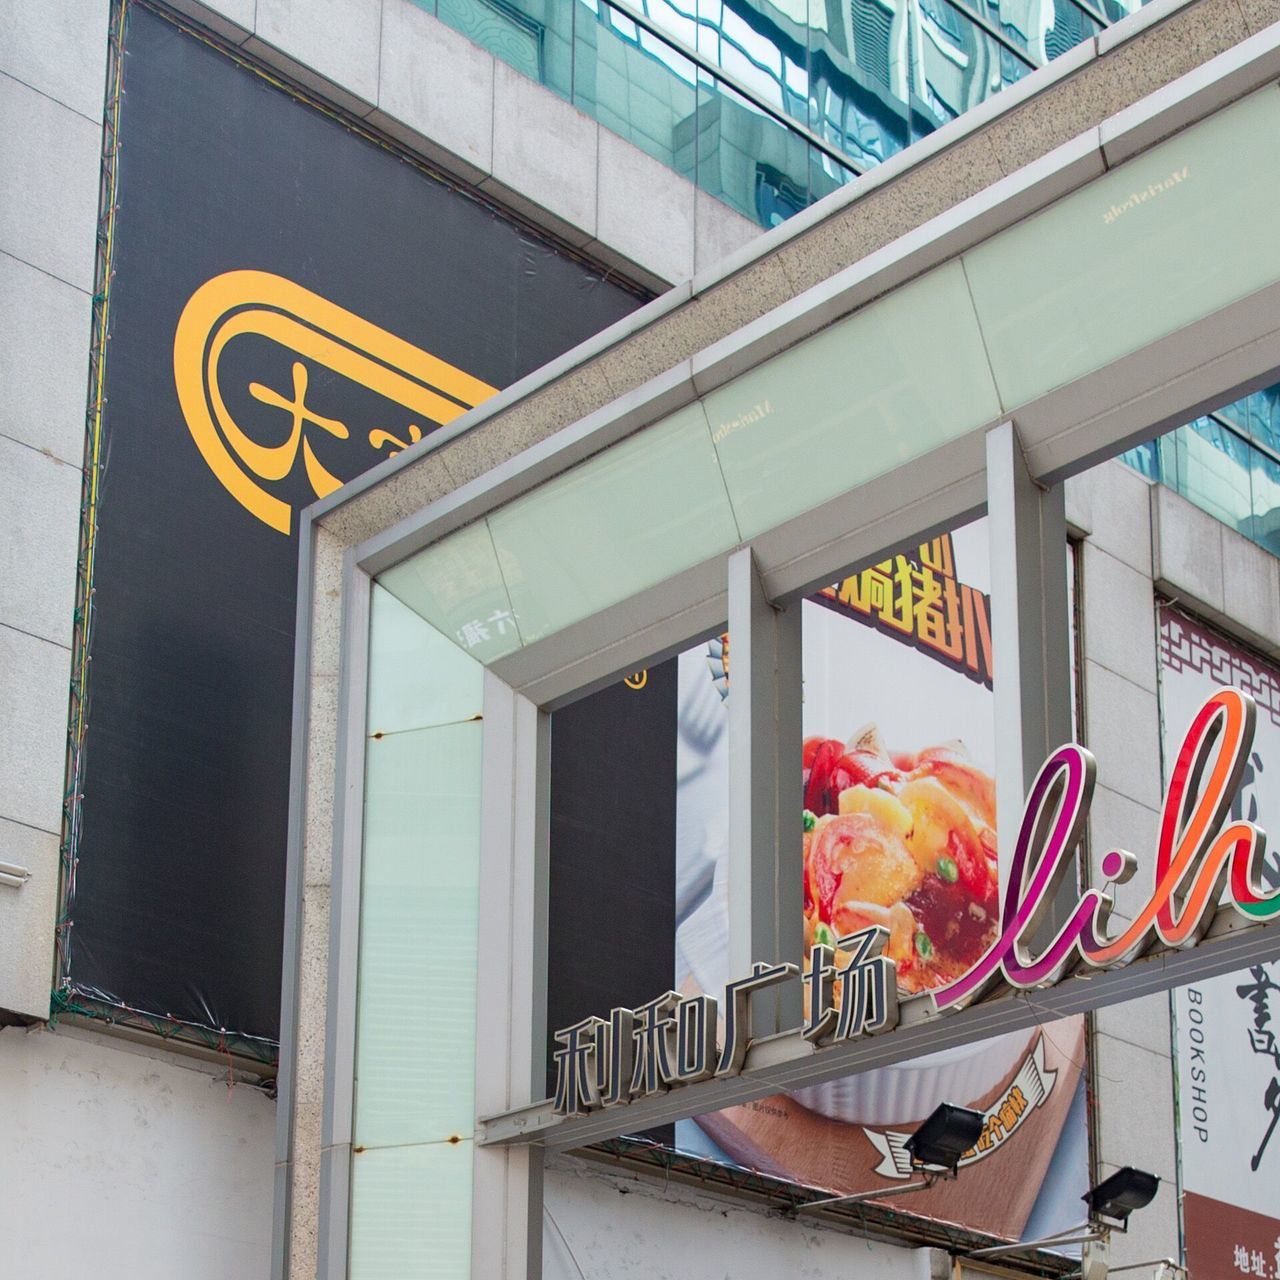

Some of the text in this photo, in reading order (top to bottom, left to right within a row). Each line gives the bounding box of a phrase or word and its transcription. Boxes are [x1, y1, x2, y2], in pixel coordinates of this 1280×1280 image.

[553, 925, 898, 1114] 利和广场
[1187, 988, 1209, 1143] BOOKSHOP
